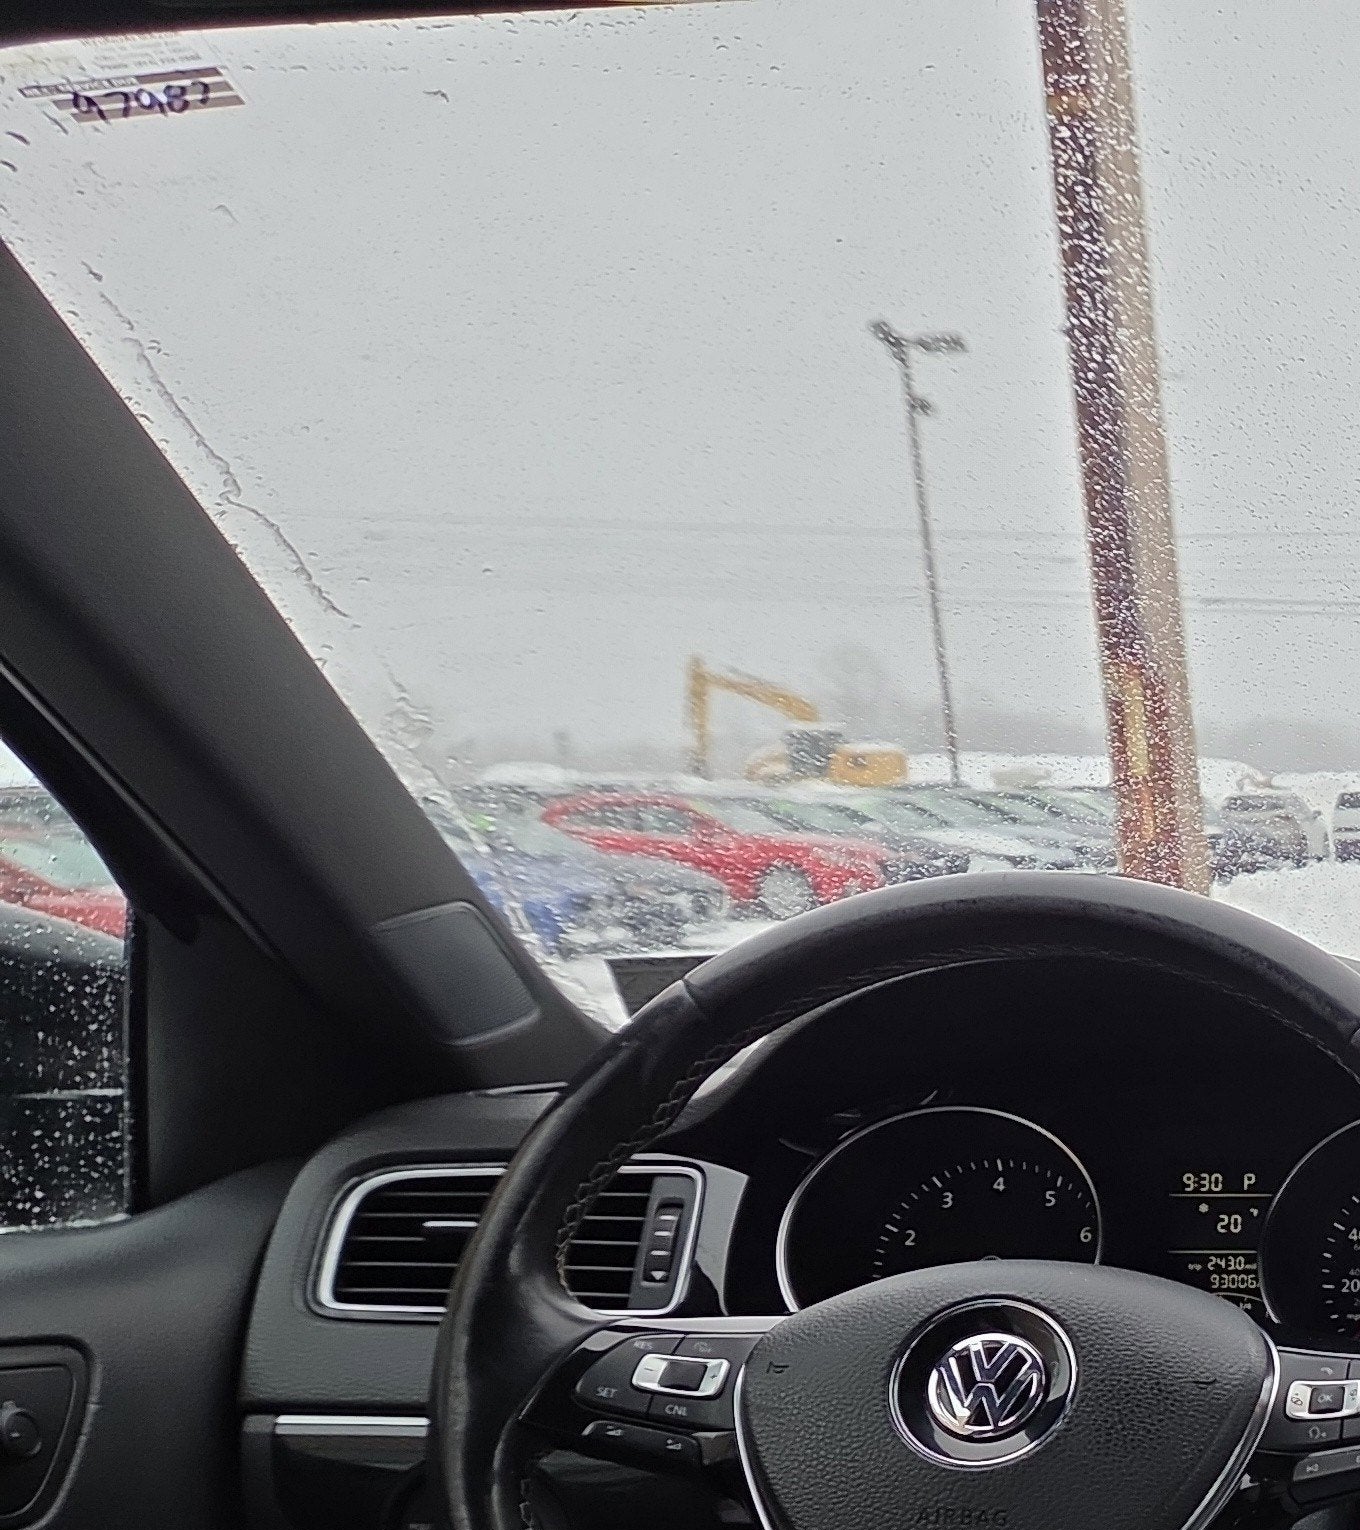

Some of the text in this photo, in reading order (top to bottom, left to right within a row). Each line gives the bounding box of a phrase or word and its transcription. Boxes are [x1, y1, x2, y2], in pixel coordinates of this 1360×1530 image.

[993, 1177, 1005, 1191] 4
[1182, 1173, 1256, 1192] 9:30 P
[941, 1192, 953, 1208] 3
[1045, 1190, 1056, 1206] 5
[1217, 1214, 1242, 1233] 20
[904, 1230, 916, 1246] 2
[1080, 1227, 1092, 1242] 6
[1210, 1274, 1256, 1289] 93006
[1341, 1278, 1360, 1293] 20
[596, 1387, 617, 1398] SET
[1317, 1393, 1333, 1403] OK
[665, 1404, 688, 1416] CNL
[916, 1507, 1008, 1528] AIRBAG
